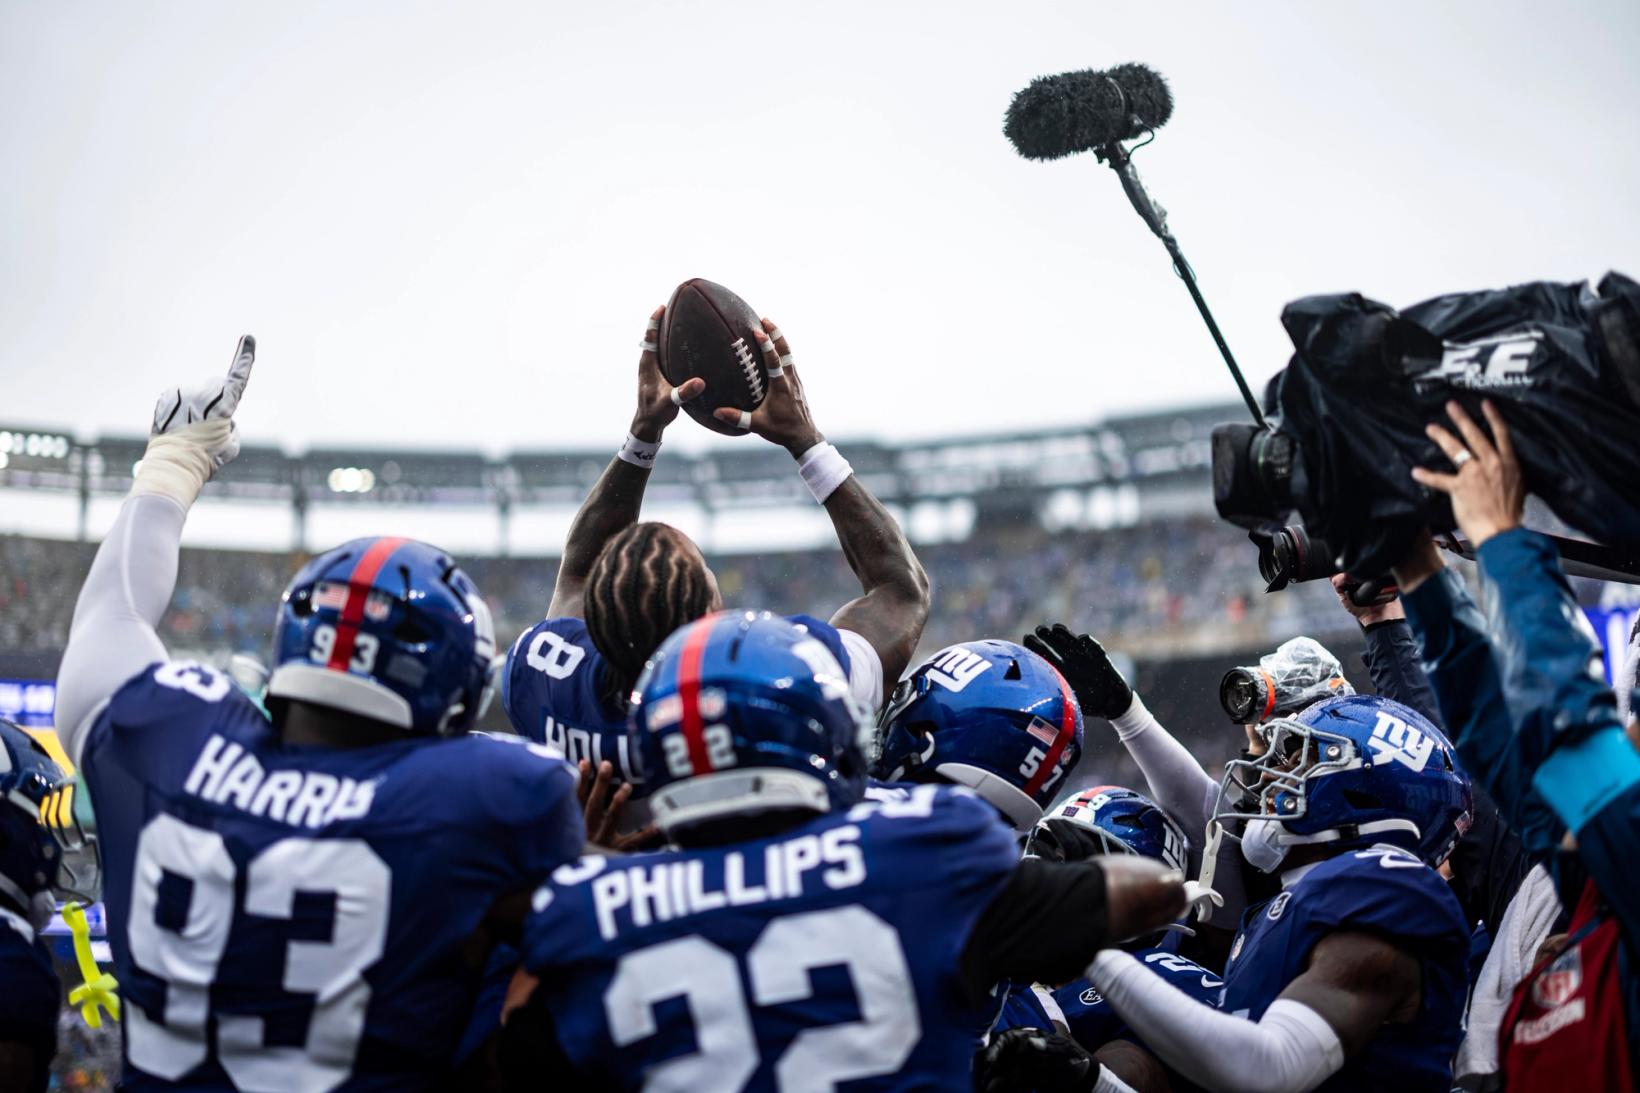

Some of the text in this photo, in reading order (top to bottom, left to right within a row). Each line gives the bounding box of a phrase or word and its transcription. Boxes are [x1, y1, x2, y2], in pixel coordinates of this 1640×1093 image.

[309, 625, 381, 676] 93
[526, 631, 586, 680] 8
[662, 723, 738, 777] 22
[1018, 746, 1064, 793] 57
[592, 825, 866, 940] PHILLIPS
[127, 812, 393, 1093] 93
[603, 902, 922, 1093] 22
